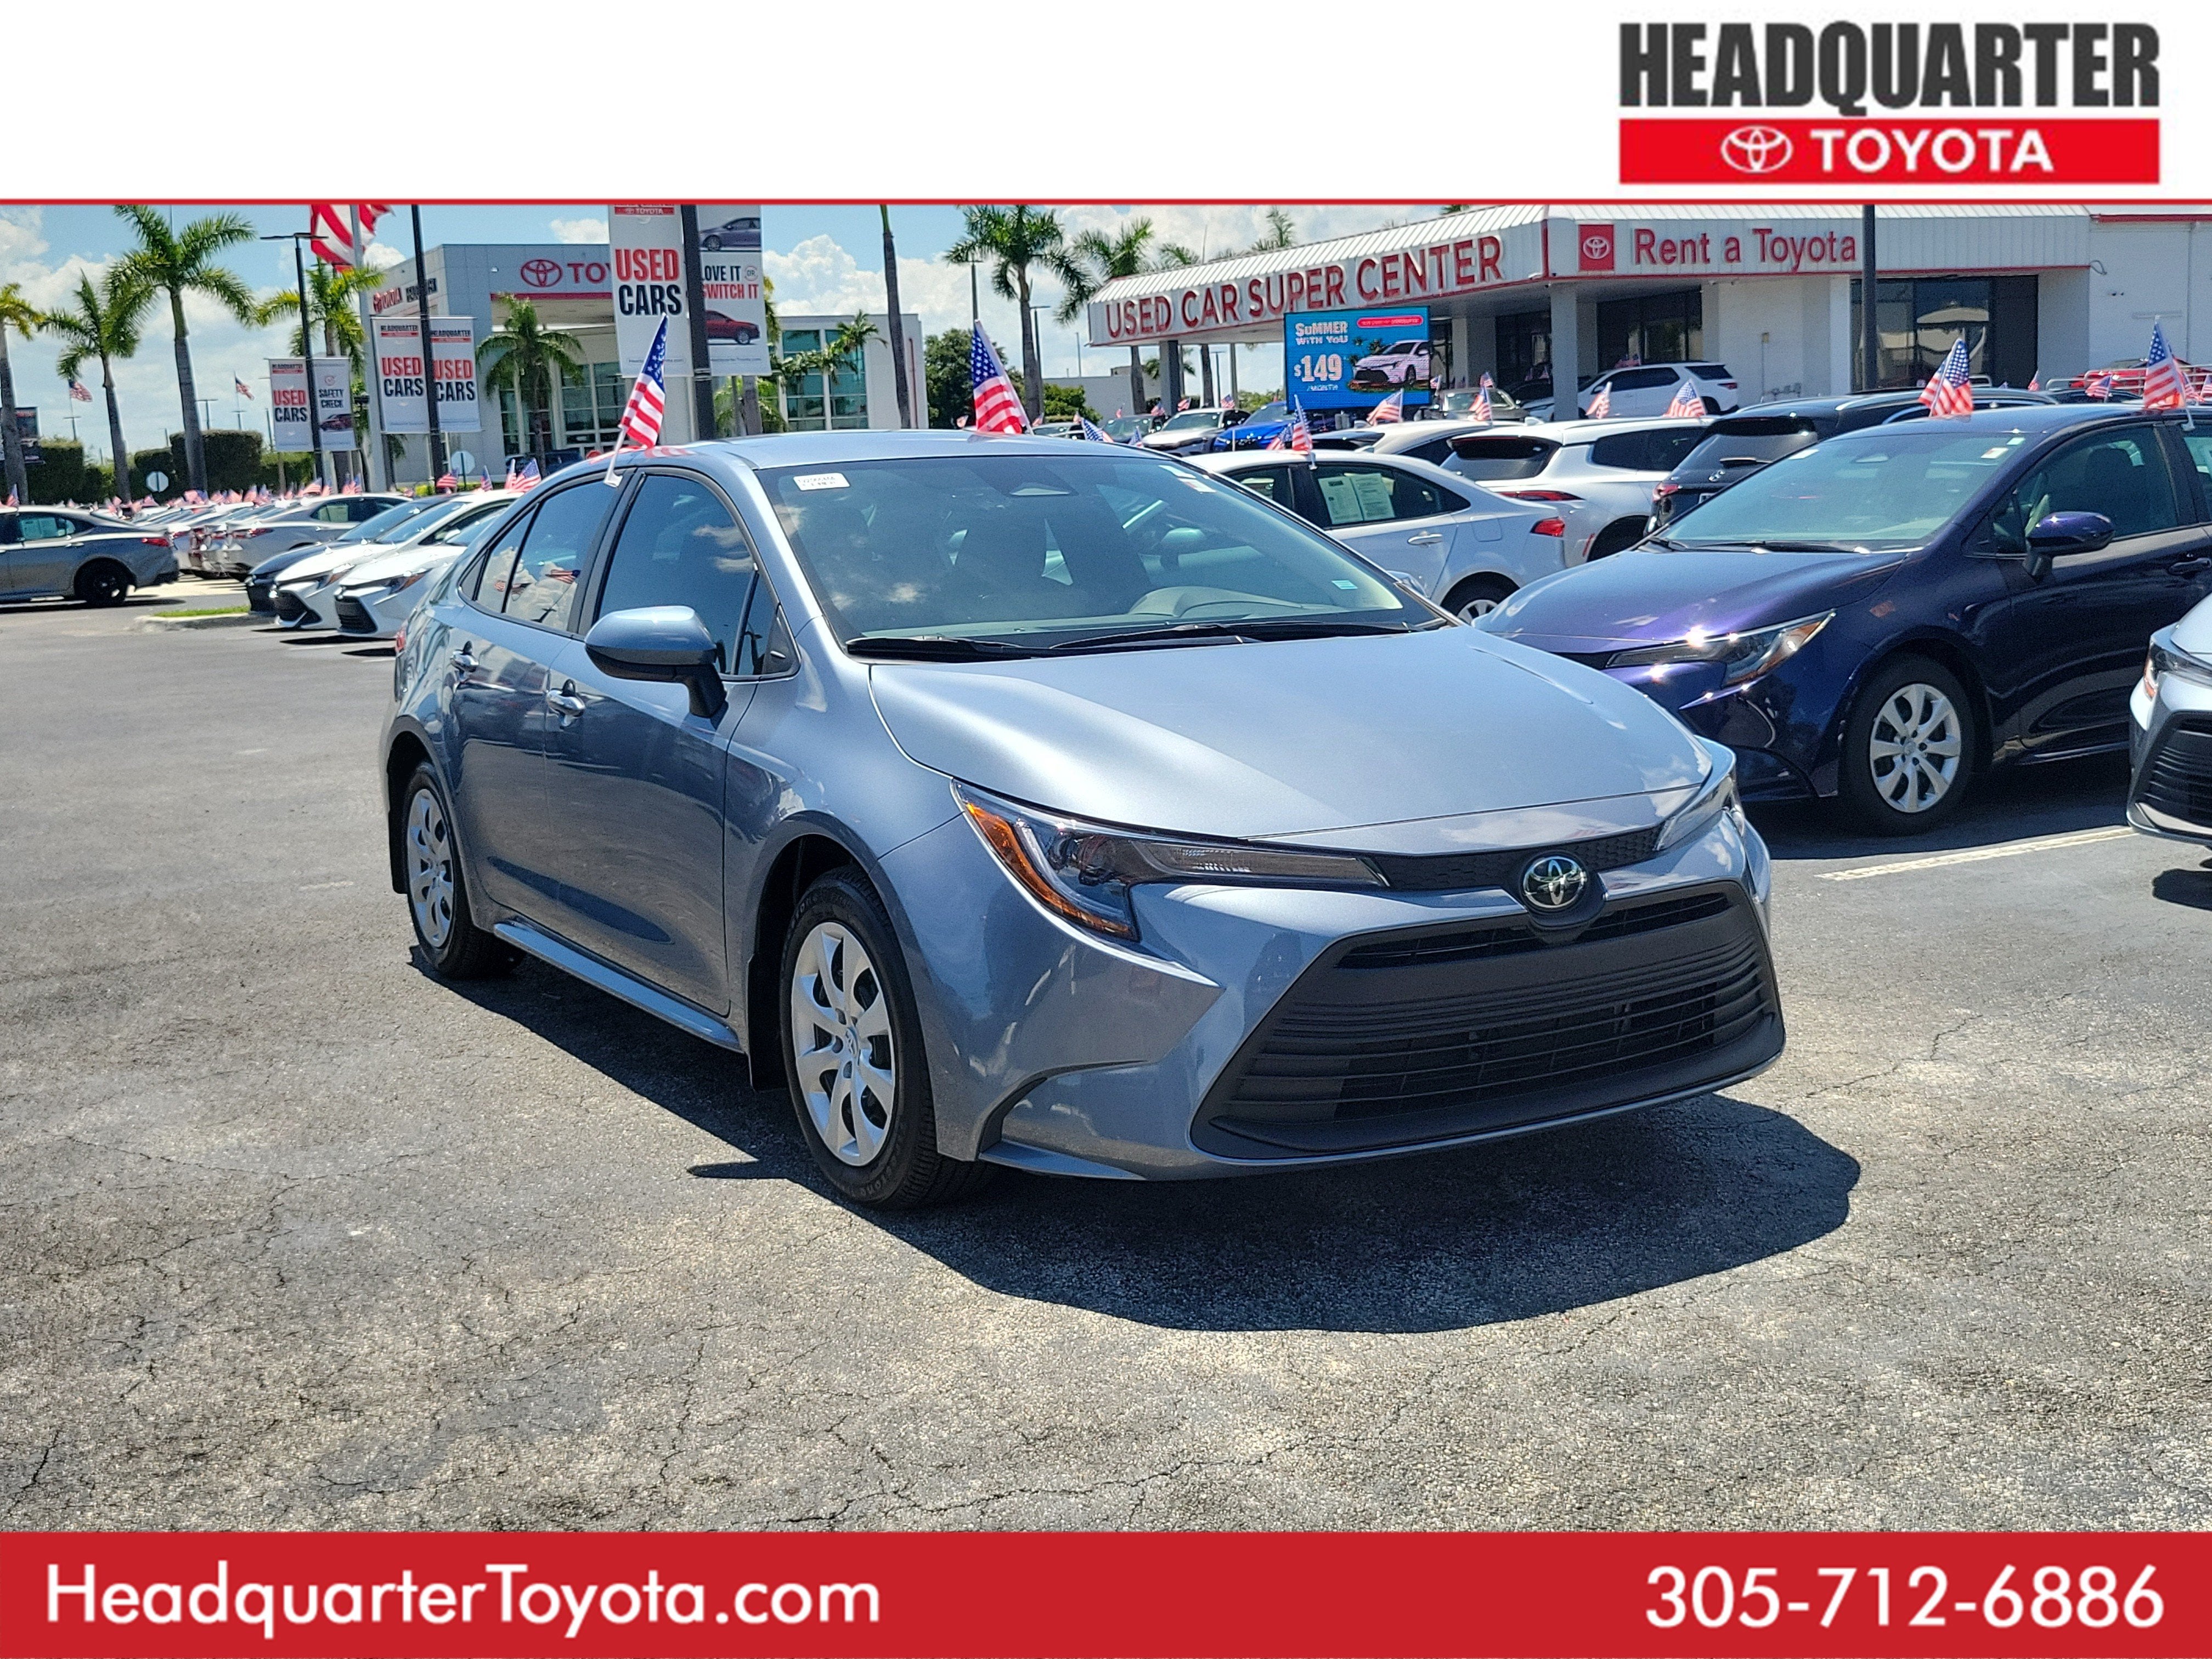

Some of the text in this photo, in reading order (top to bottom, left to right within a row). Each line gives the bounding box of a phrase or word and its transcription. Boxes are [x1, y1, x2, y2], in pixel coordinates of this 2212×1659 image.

[1634, 228, 1857, 273] Rent a Toyota
[615, 249, 680, 281] USED
[703, 265, 726, 281] OVE
[730, 266, 741, 281] IT
[748, 284, 758, 299] IT
[1106, 235, 1503, 338] USED CAR SUPER CENTER
[618, 284, 682, 316] CARS
[382, 357, 421, 376] USED
[433, 359, 473, 380] USED
[1294, 353, 1342, 382] $149
[319, 389, 343, 398] SAFETY
[383, 378, 424, 397] CARS
[436, 381, 476, 402] CARS
[274, 390, 306, 406] USED
[321, 399, 343, 408] CHECK
[275, 407, 308, 422] CARS
